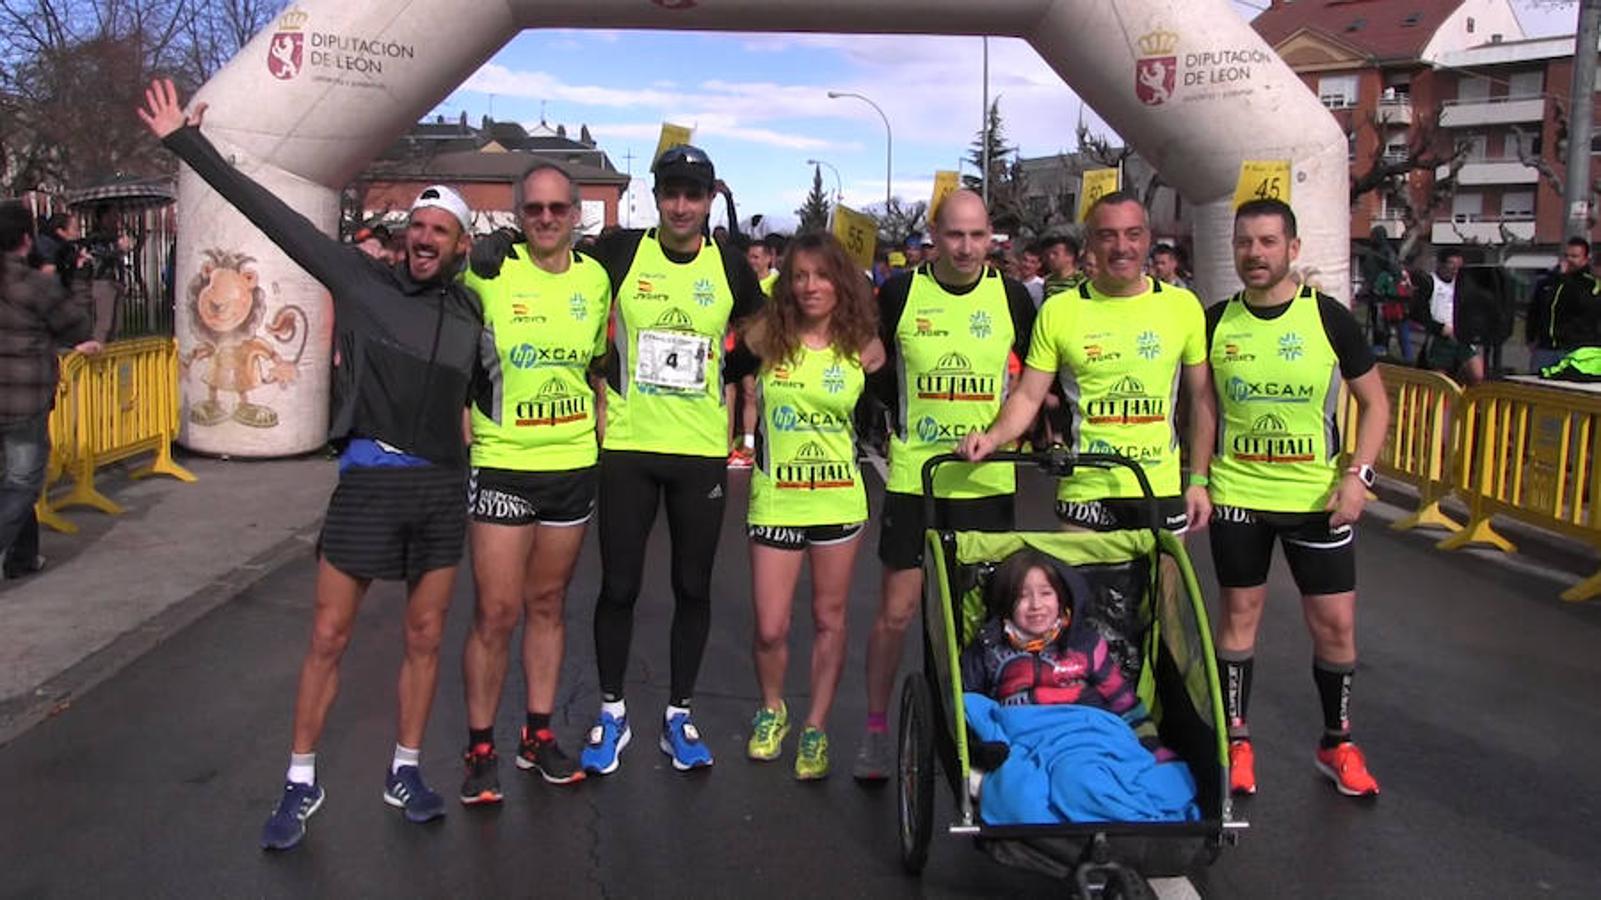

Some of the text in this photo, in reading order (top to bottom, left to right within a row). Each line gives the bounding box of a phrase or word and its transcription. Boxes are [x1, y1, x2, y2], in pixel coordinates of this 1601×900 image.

[311, 33, 414, 58] DIPUTACIÓN
[311, 51, 331, 67] DE
[1184, 71, 1205, 86] DE
[1254, 177, 1280, 200] 45
[512, 343, 536, 369] hp
[666, 353, 678, 369] 4
[1248, 382, 1314, 396] XCAM
